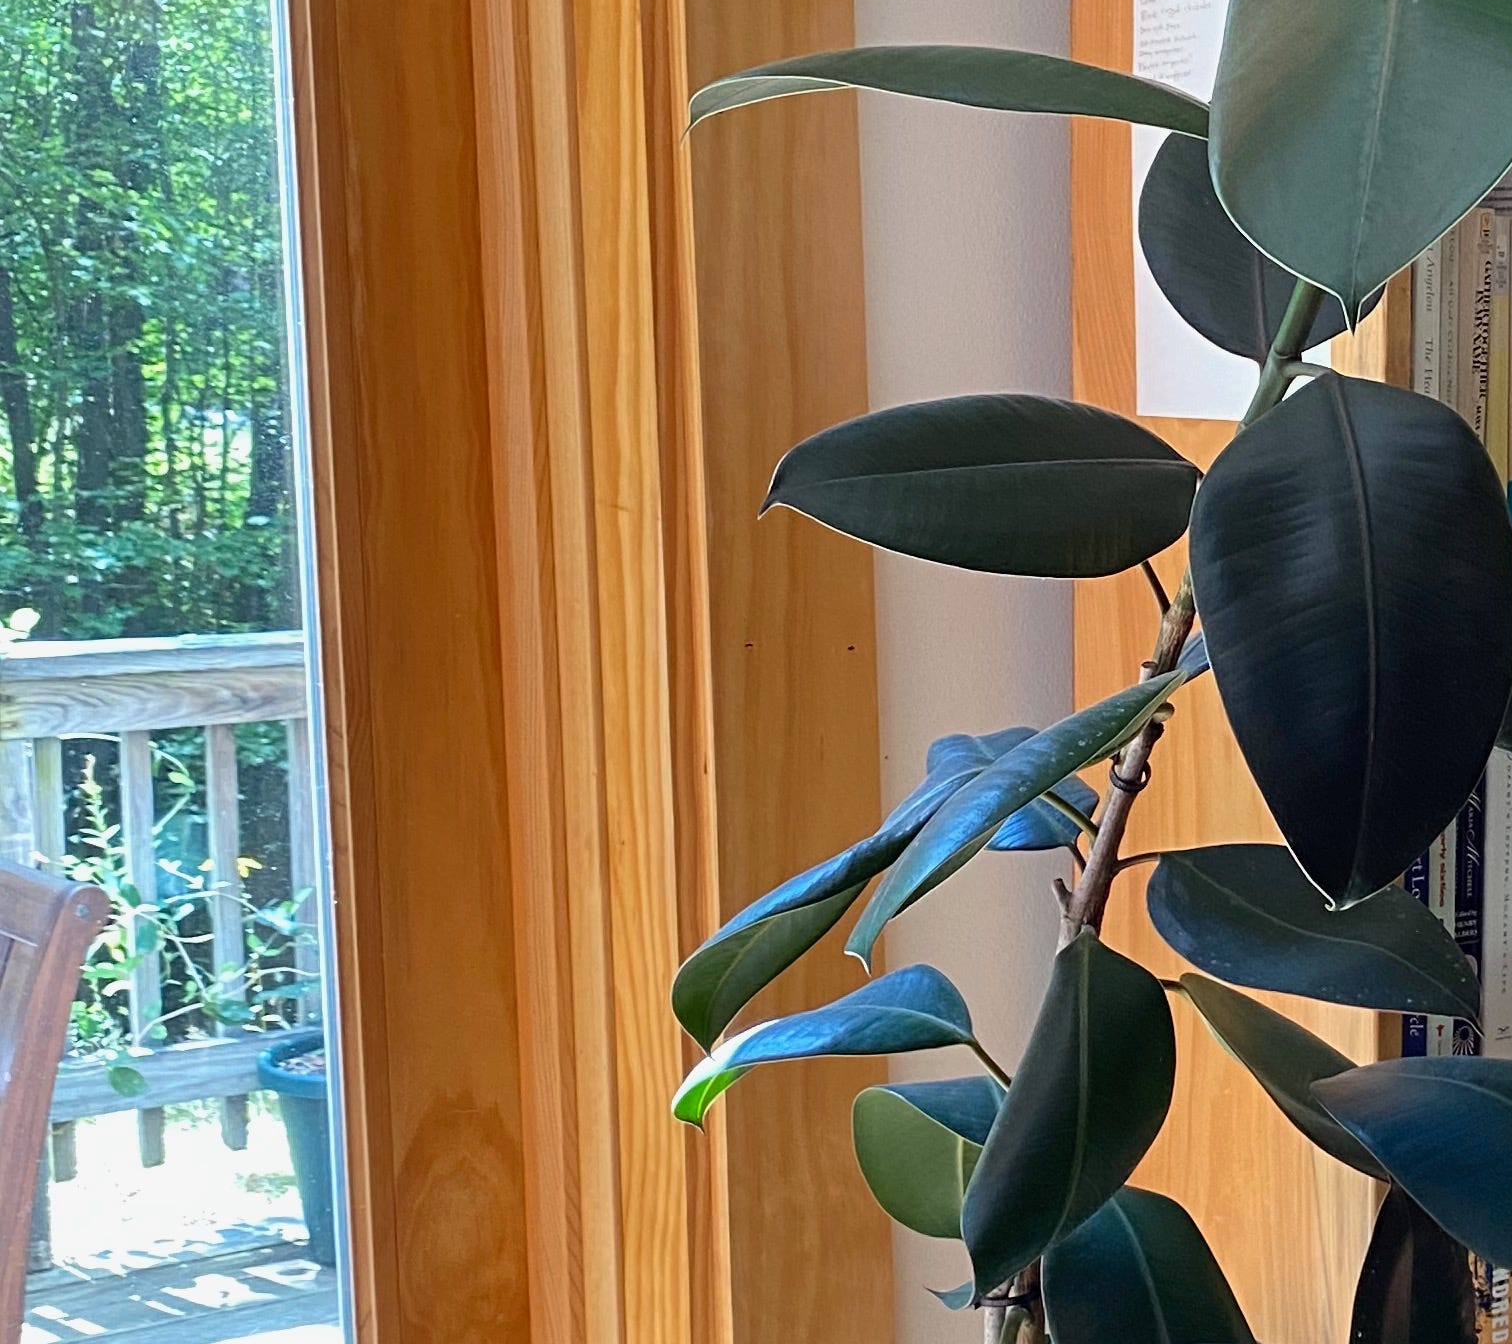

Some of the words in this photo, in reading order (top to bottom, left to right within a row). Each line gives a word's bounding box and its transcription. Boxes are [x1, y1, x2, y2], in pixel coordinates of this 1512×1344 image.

[1425, 257, 1436, 312] Angelou
[1424, 337, 1436, 362] The
[1465, 829, 1481, 899] MITCHELL
